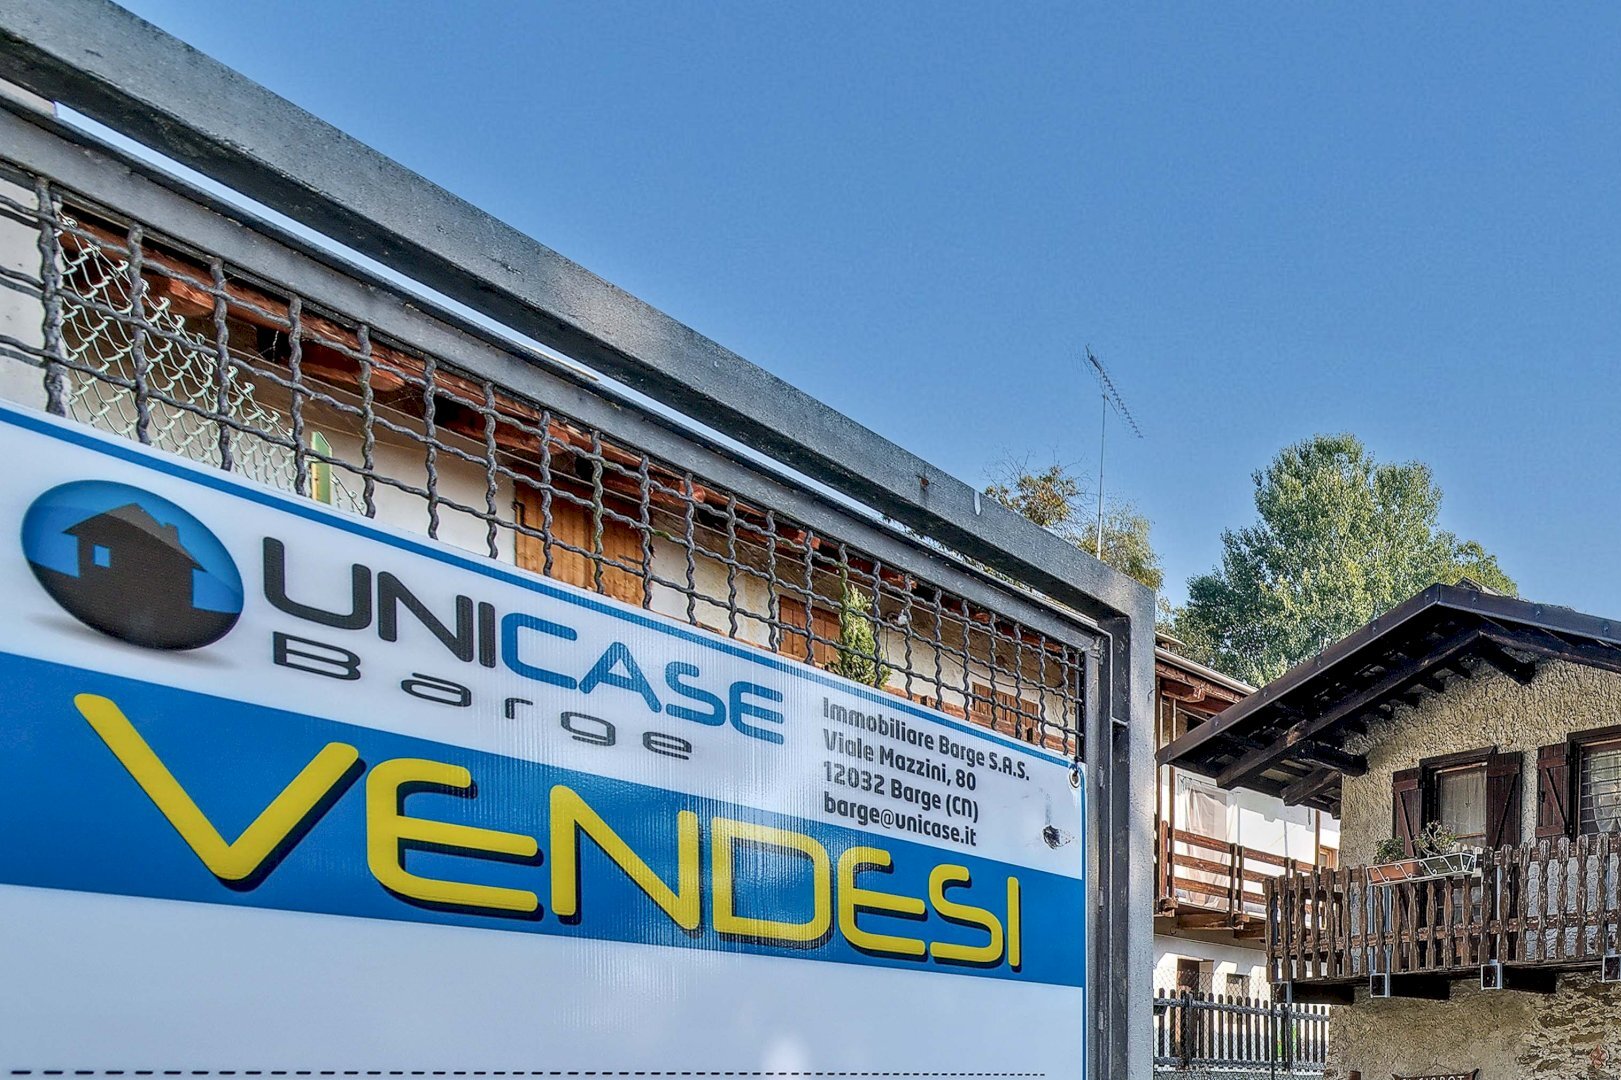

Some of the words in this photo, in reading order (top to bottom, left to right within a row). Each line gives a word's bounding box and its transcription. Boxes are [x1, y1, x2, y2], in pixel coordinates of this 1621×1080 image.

[263, 536, 784, 745] UNICASE
[273, 631, 692, 760] Barge
[823, 697, 934, 751] Immobiliare
[939, 735, 985, 768] Barge
[989, 751, 1030, 781] S.A.S.
[823, 728, 874, 762] Viale
[879, 745, 952, 786] Mazzini,
[955, 769, 976, 791] 80
[823, 761, 885, 796] 12032
[891, 778, 941, 811] Barge
[823, 791, 977, 847] barge@unicase.it
[74, 693, 1023, 970] VENDESI
